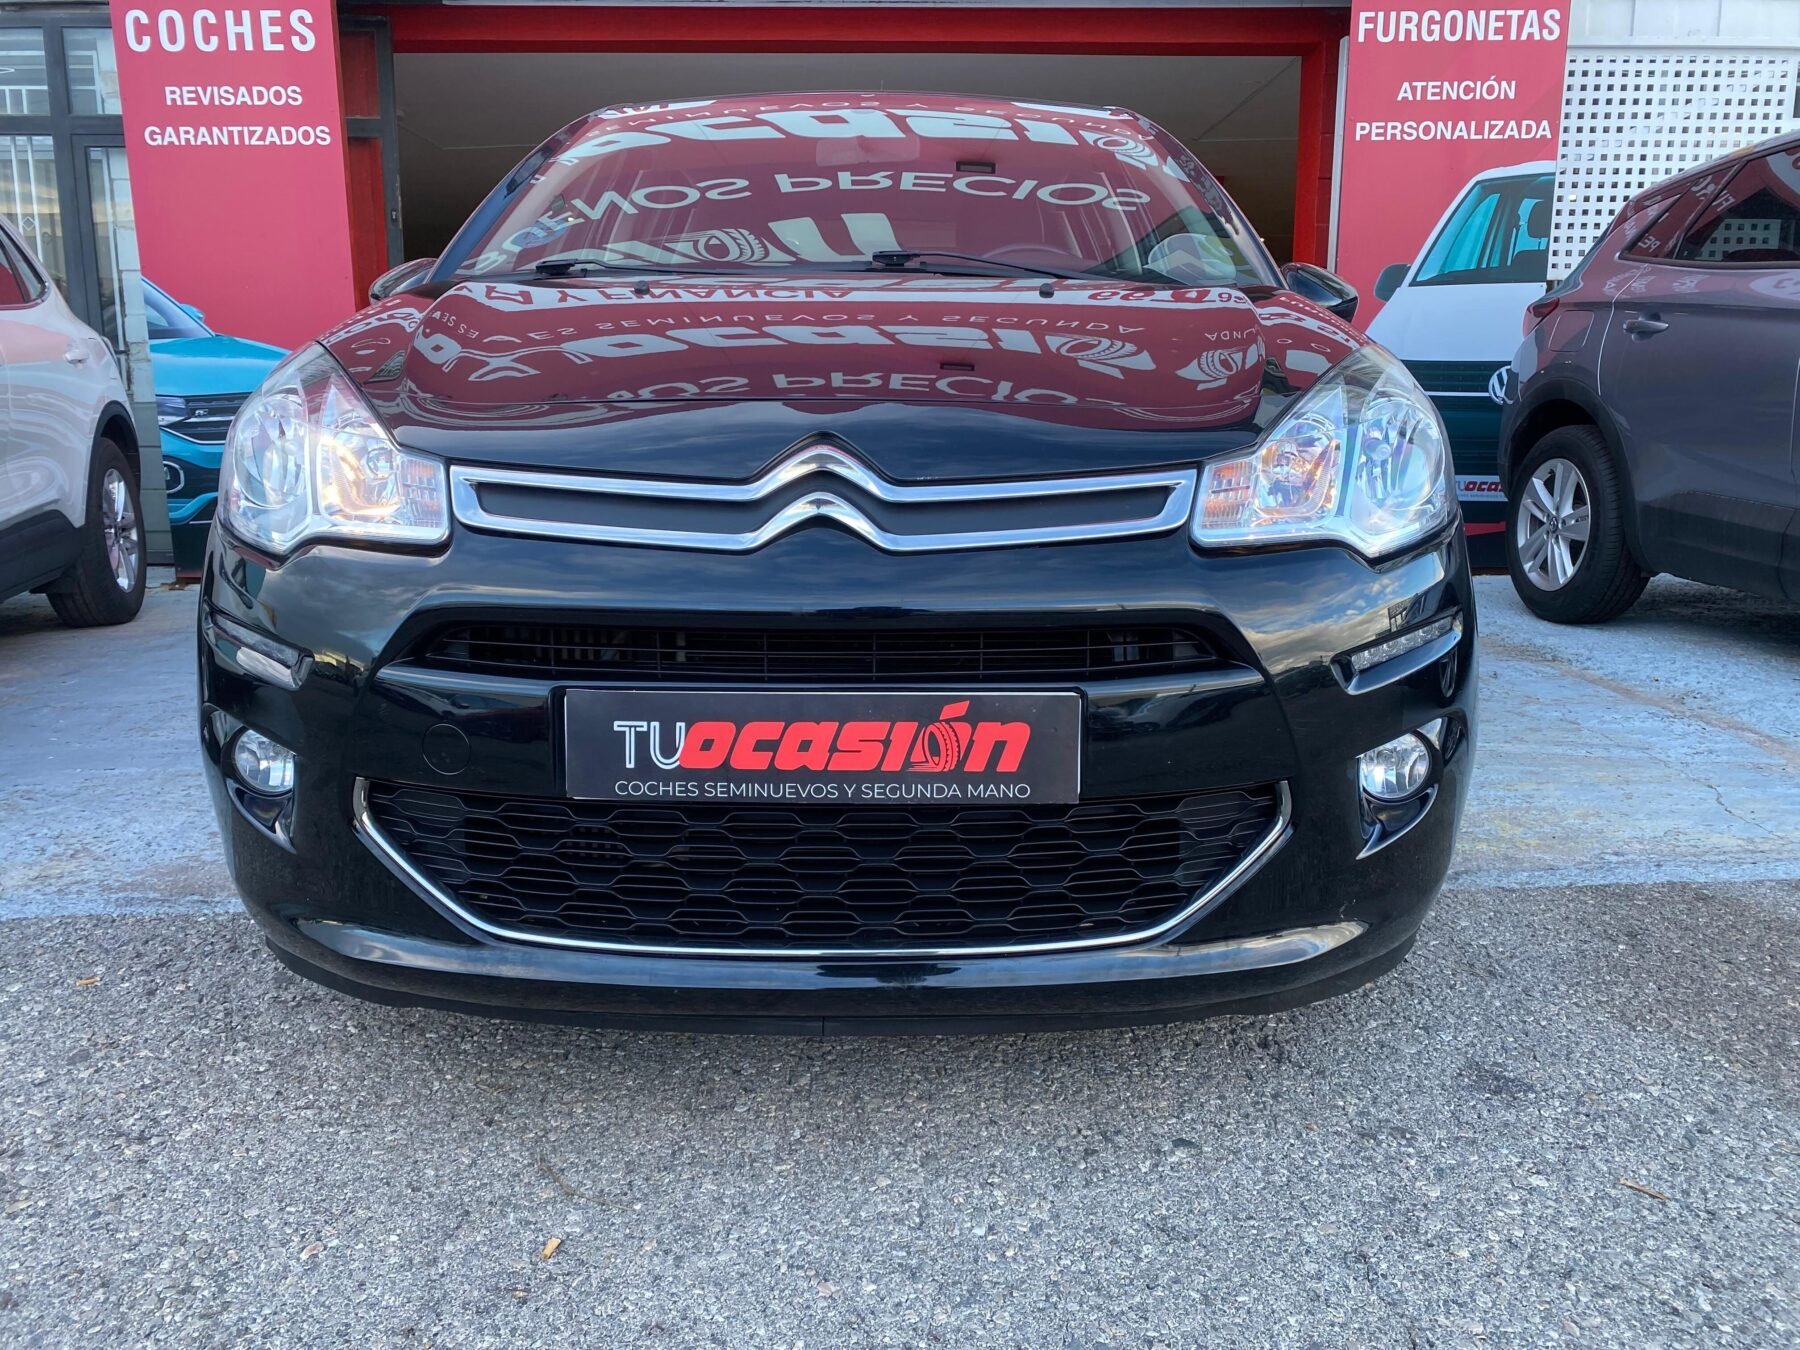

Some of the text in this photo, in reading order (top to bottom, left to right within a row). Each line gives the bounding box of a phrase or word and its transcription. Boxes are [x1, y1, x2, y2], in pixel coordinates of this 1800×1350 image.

[125, 9, 316, 52] COCHES
[1357, 9, 1561, 42] FURGONETAS
[164, 85, 303, 106] REVISADOS
[1397, 75, 1516, 101] ATENCIÓN
[144, 126, 331, 146] GARANTIZADOS
[1355, 120, 1552, 141] PERSONALIZADA
[614, 780, 1031, 799] COCHES SEMINUEVOS Y SEGUNDA MANO
